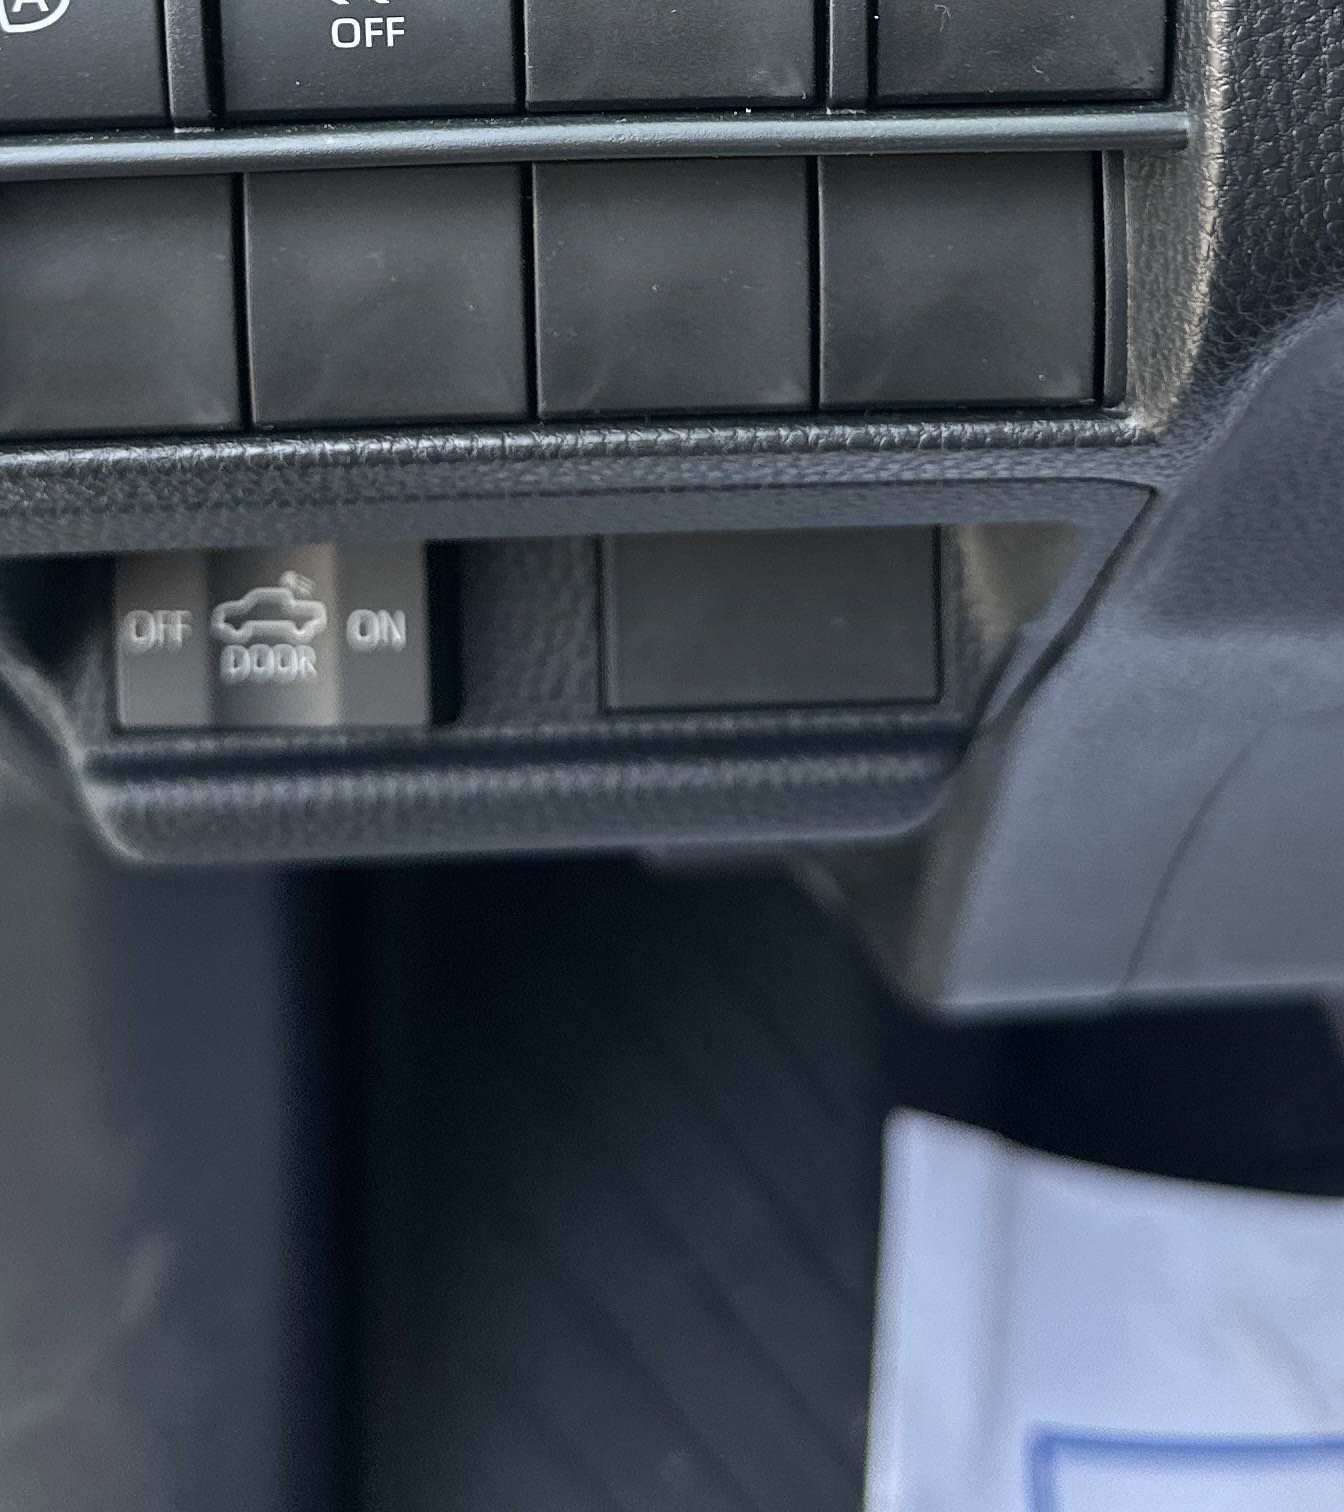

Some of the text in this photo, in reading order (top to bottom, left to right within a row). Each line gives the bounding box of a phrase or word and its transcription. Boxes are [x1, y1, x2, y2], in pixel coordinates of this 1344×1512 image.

[331, 16, 405, 49] OFF
[122, 609, 193, 653] OFF
[346, 608, 407, 653] ON
[219, 643, 318, 683] DOOR
